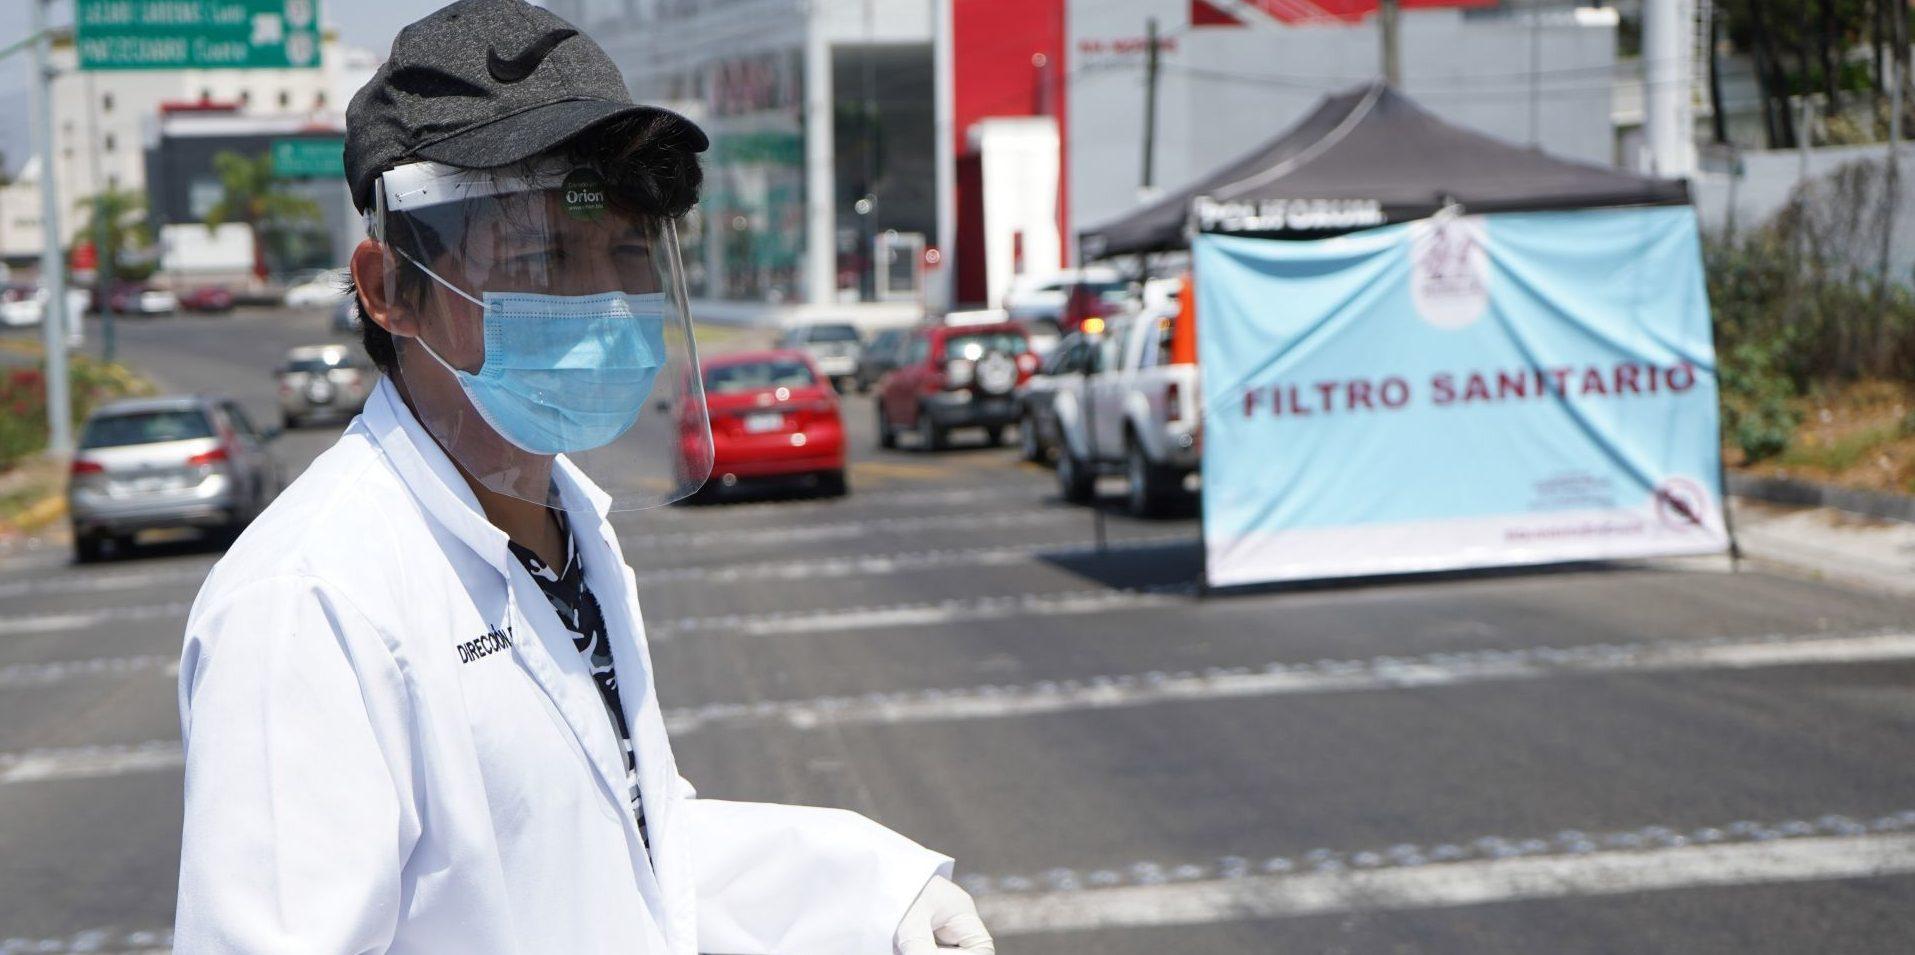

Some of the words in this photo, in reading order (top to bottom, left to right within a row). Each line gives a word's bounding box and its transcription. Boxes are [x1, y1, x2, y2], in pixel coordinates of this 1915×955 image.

[565, 188, 604, 204] Orion
[1242, 377, 1411, 419] FILTRO
[1430, 360, 1697, 406] SANITARIO
